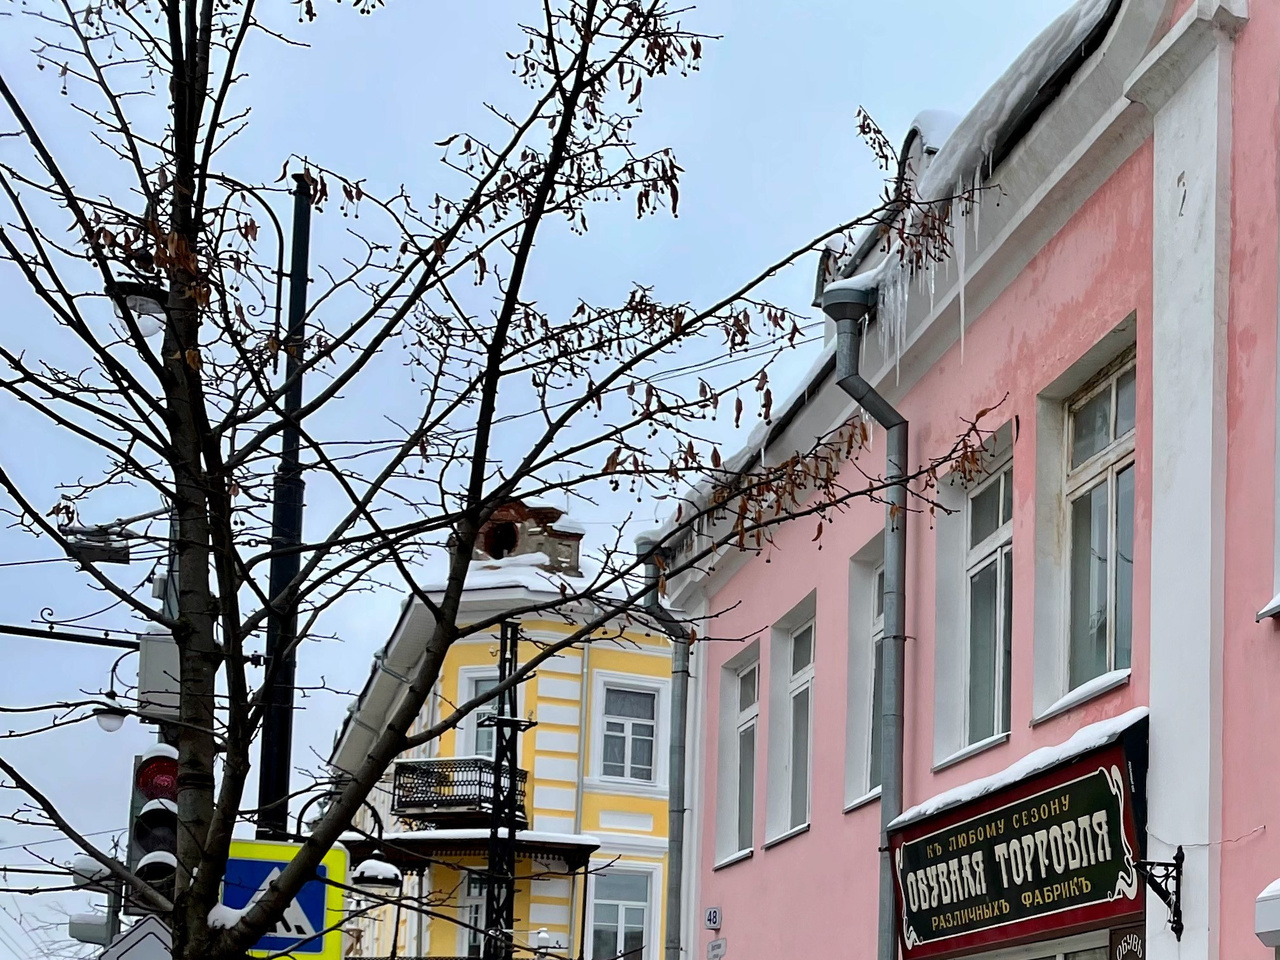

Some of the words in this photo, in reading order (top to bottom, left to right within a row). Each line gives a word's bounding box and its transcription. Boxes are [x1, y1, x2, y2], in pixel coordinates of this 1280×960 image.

[926, 843, 942, 859] КЪ
[949, 819, 1005, 851] ЛЮБОМУ
[1013, 794, 1070, 829] СЕЗОНУ
[906, 850, 987, 913] ОБУВНАЯ
[994, 809, 1112, 889] ТОРГОВЛЯ
[707, 910, 718, 925] 48
[931, 899, 1010, 931] РАЗЛИЧНЫХЪ
[1021, 876, 1092, 908] ФАБРИКЪ
